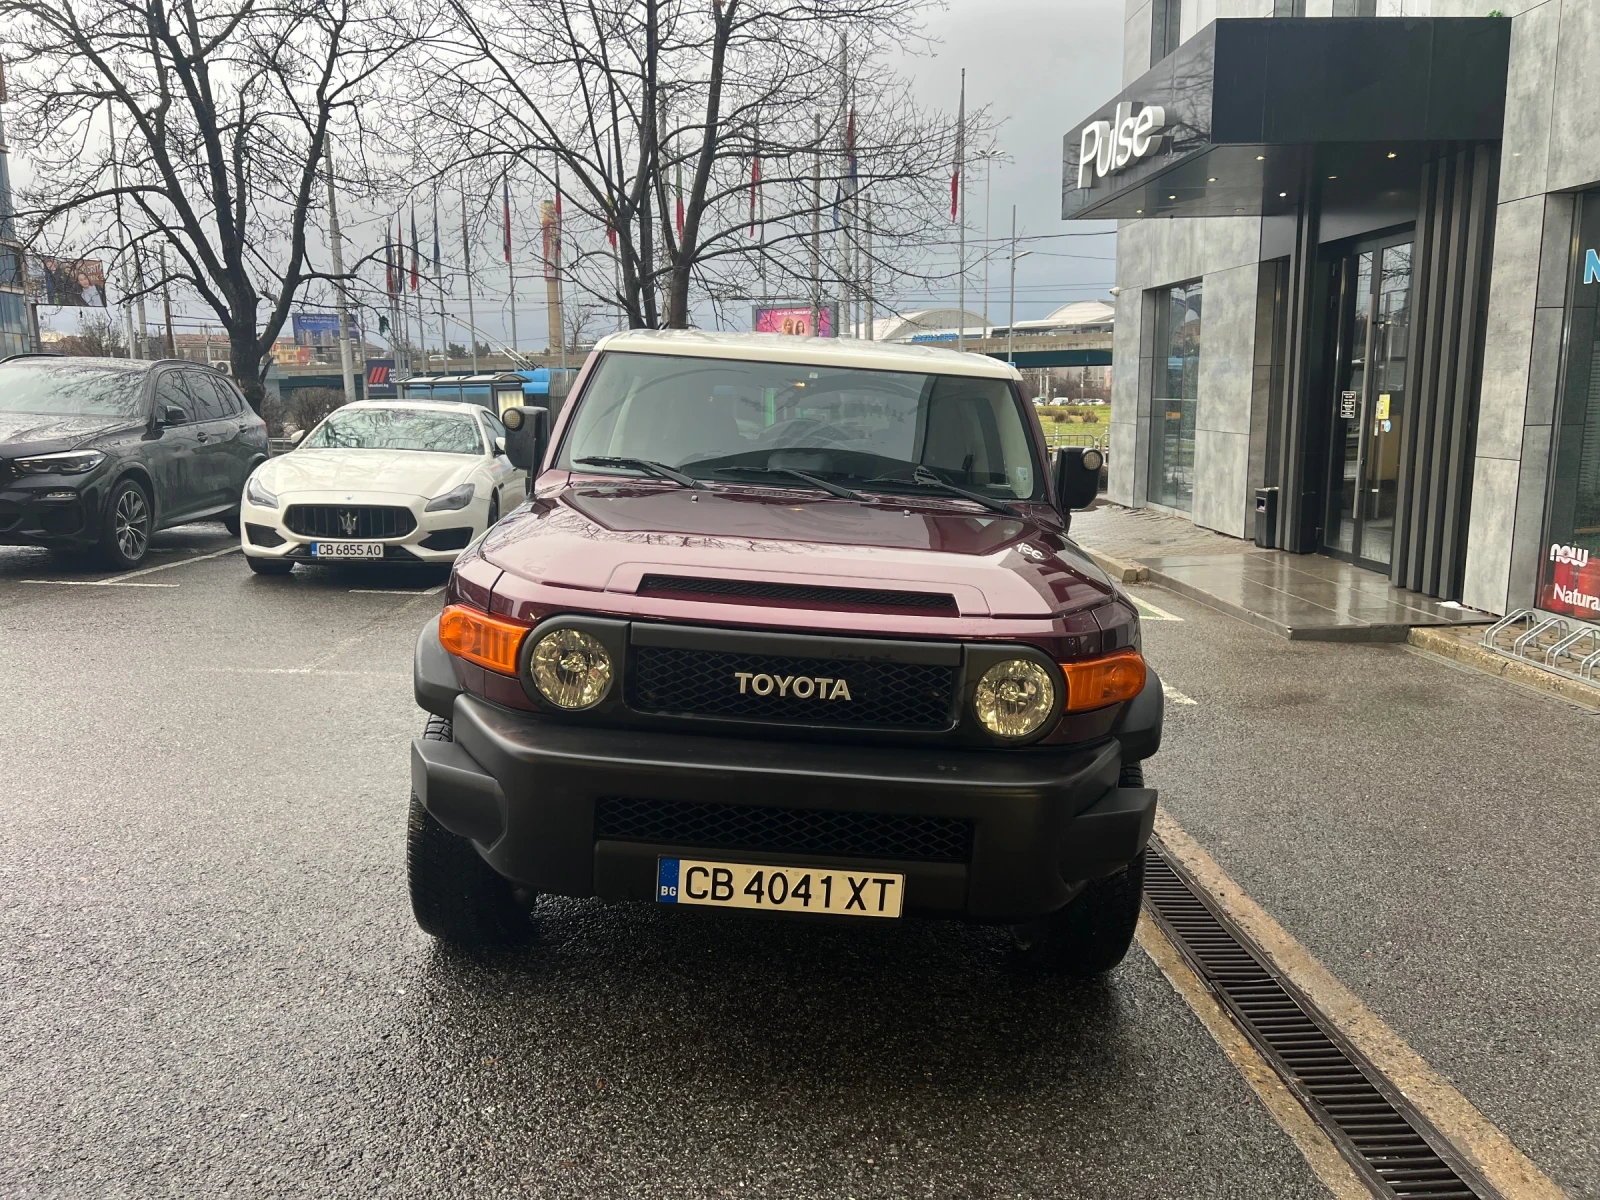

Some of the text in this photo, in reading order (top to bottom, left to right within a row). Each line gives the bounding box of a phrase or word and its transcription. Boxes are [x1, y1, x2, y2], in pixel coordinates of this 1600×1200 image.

[1077, 101, 1165, 189] Pulse
[318, 544, 334, 555] CB
[335, 544, 364, 555] 6855
[1549, 543, 1589, 567] now
[734, 672, 851, 701] TOYOTA
[660, 885, 677, 896] BG
[685, 866, 896, 912] CB 4041 XT
